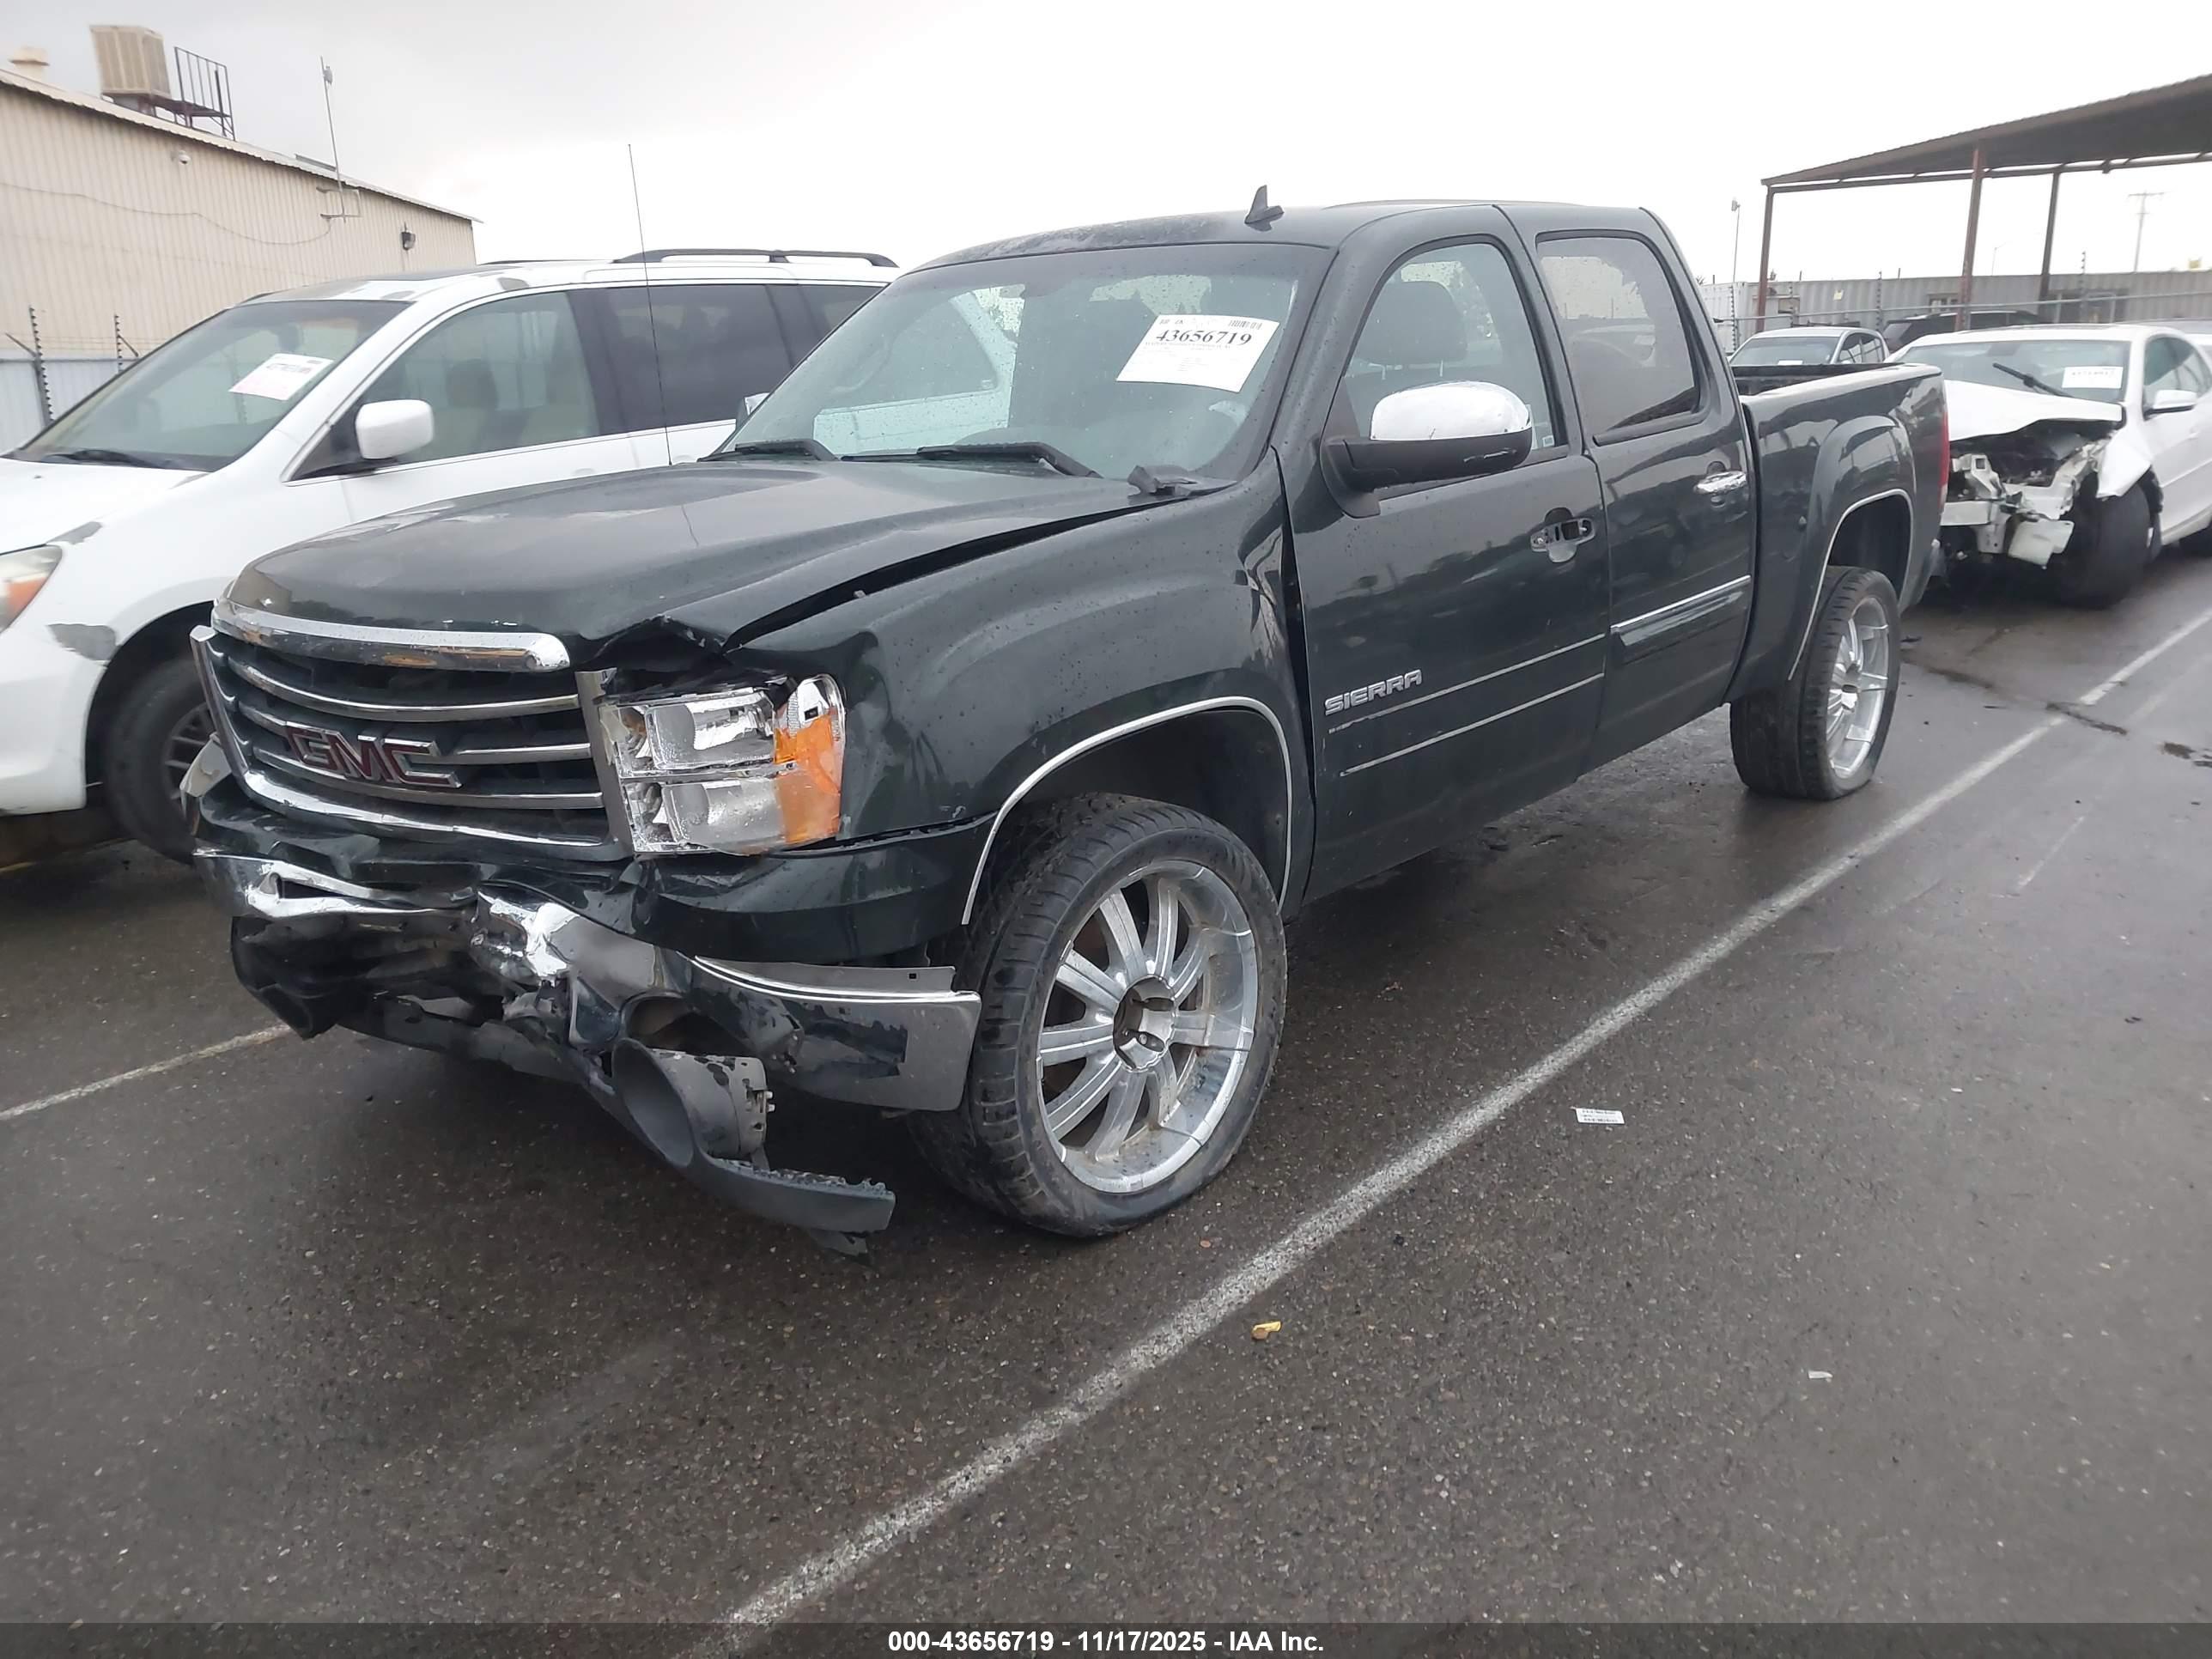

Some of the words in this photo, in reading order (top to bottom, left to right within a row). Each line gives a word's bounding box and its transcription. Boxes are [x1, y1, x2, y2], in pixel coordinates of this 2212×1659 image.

[1156, 330, 1252, 345] 43656719
[1325, 669, 1423, 716] SIERRA
[285, 720, 463, 787] GMC
